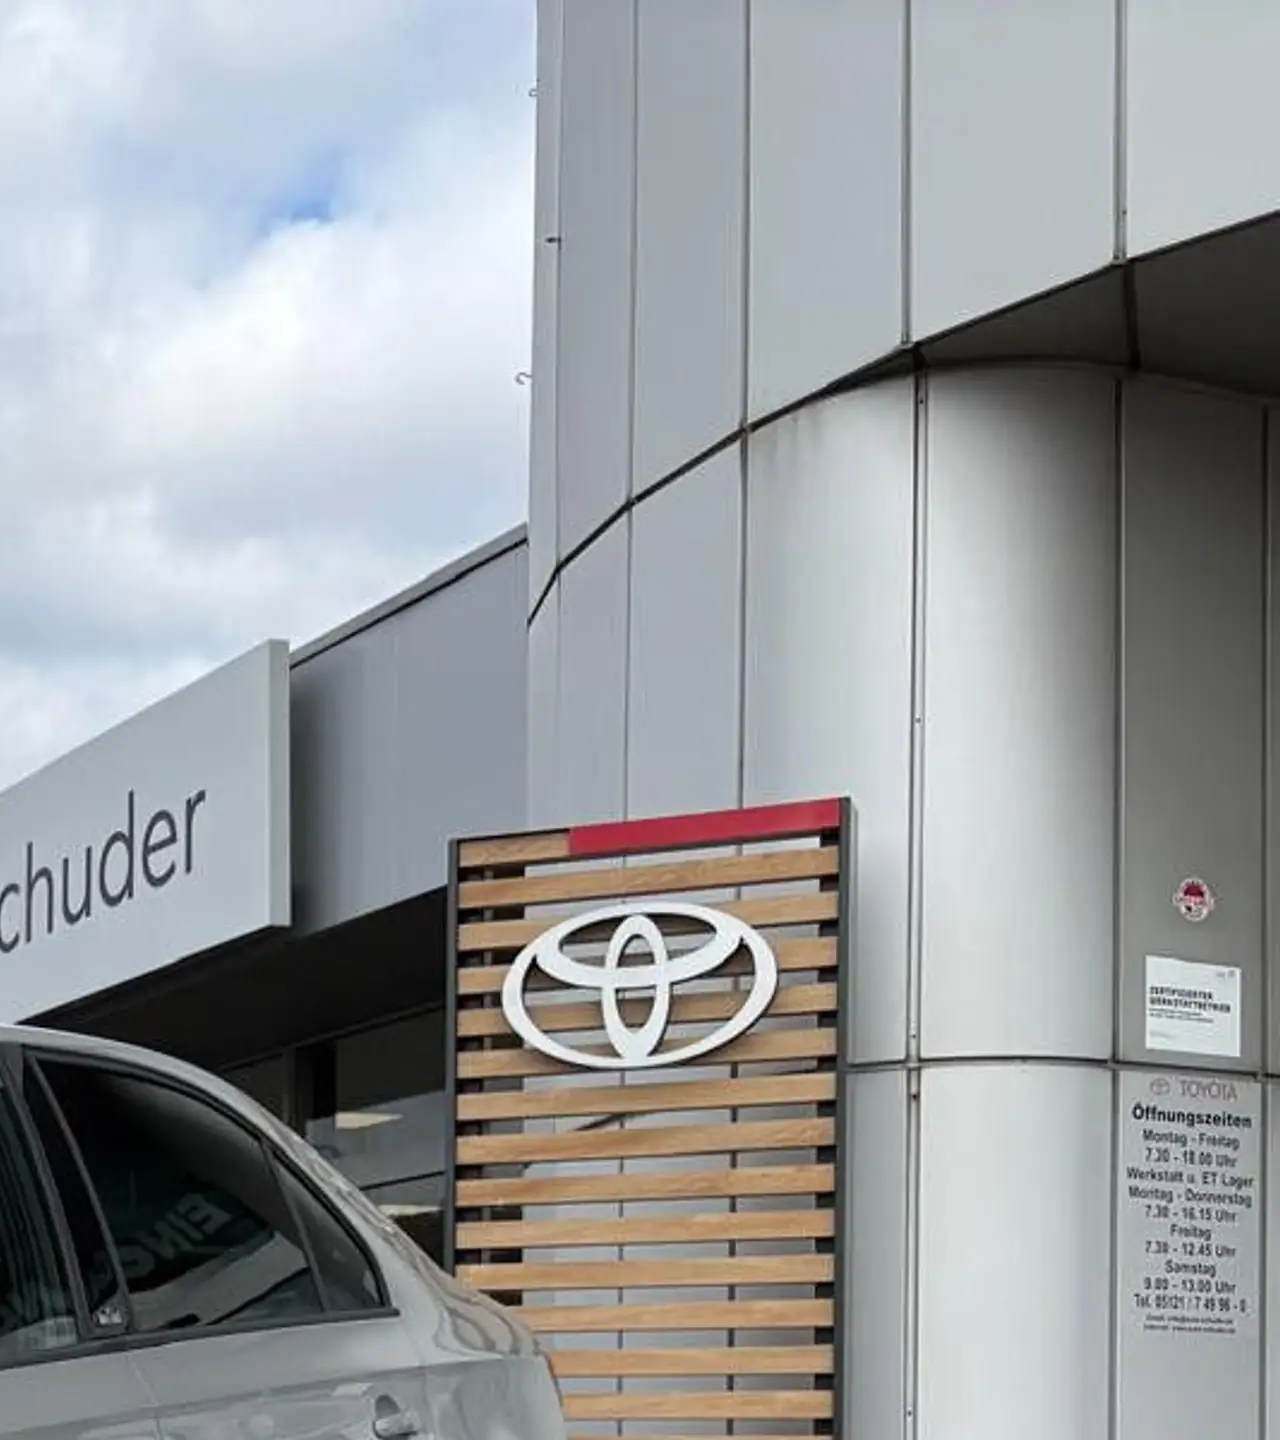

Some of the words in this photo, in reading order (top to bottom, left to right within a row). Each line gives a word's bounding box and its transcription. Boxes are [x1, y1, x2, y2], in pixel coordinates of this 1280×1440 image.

[1179, 1078, 1238, 1102] TOYOTA
[1131, 1102, 1253, 1129] Öffnungszeiten
[1142, 1127, 1188, 1149] Montag
[1198, 1131, 1240, 1152] Freitag
